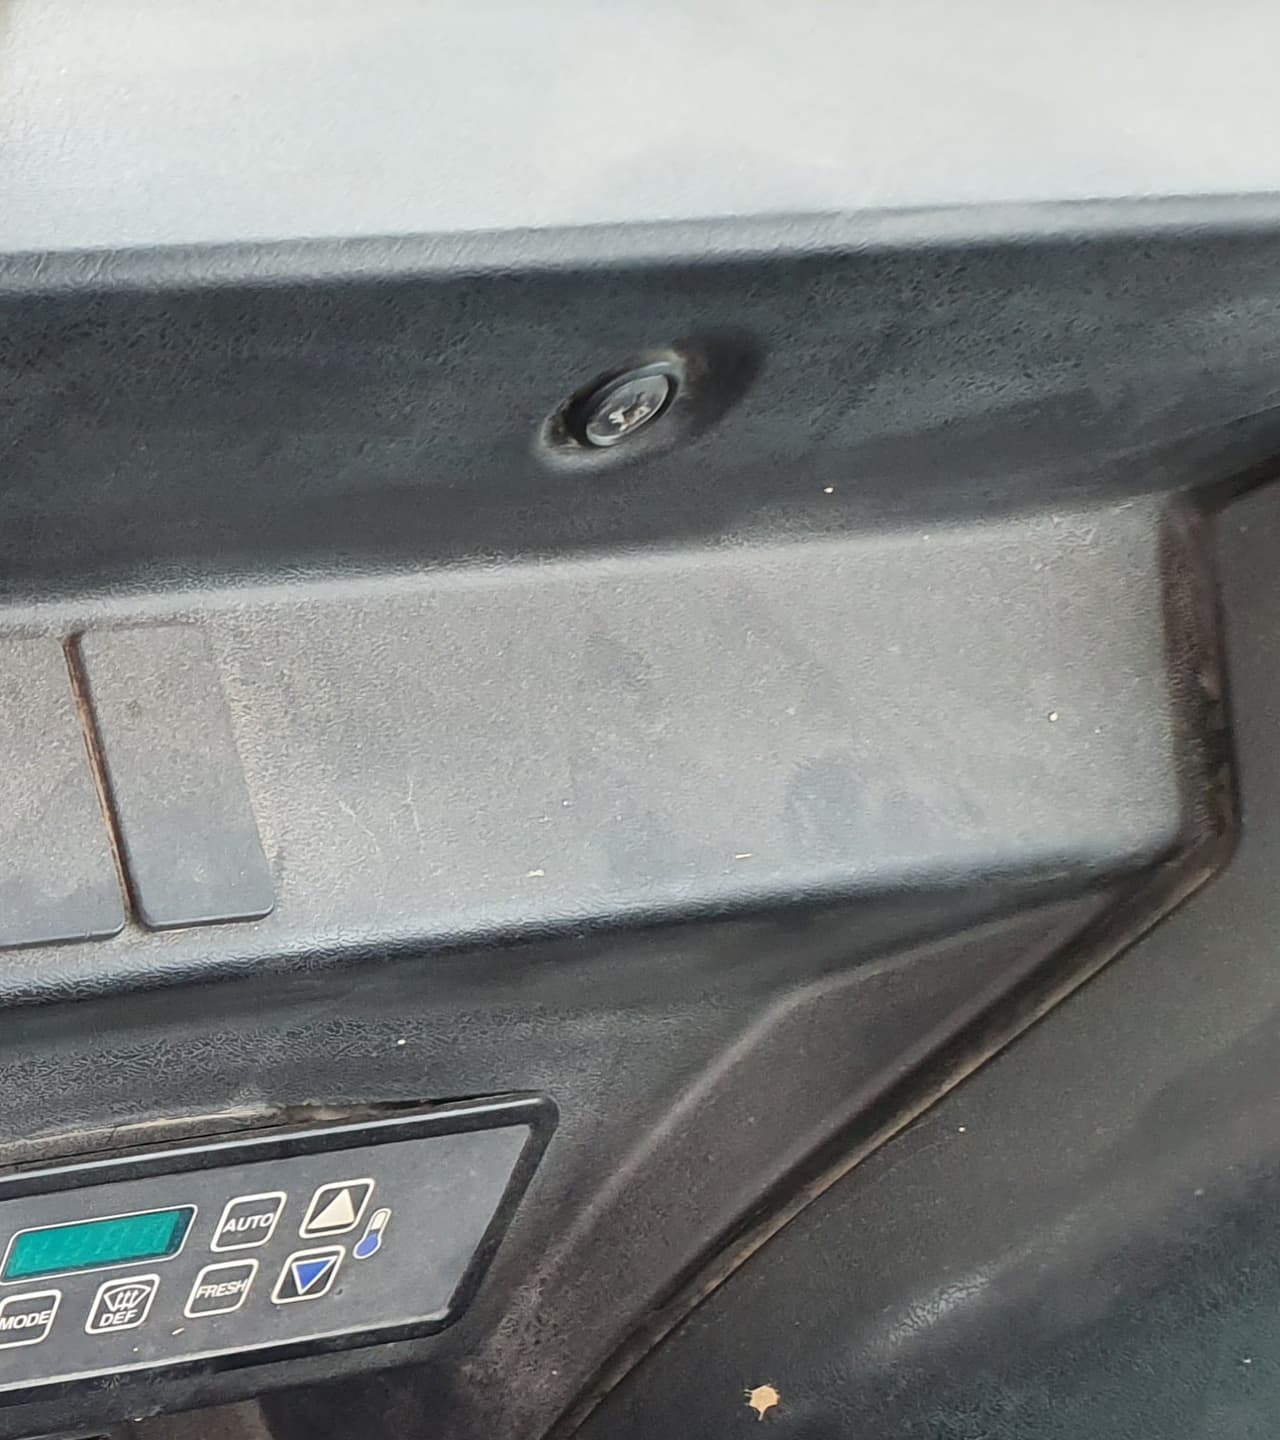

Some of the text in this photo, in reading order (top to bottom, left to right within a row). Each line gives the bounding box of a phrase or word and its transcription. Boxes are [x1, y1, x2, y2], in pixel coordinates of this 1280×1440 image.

[222, 1211, 275, 1236] AUTO
[196, 1278, 247, 1301] FRESH
[99, 1307, 138, 1327] DEF
